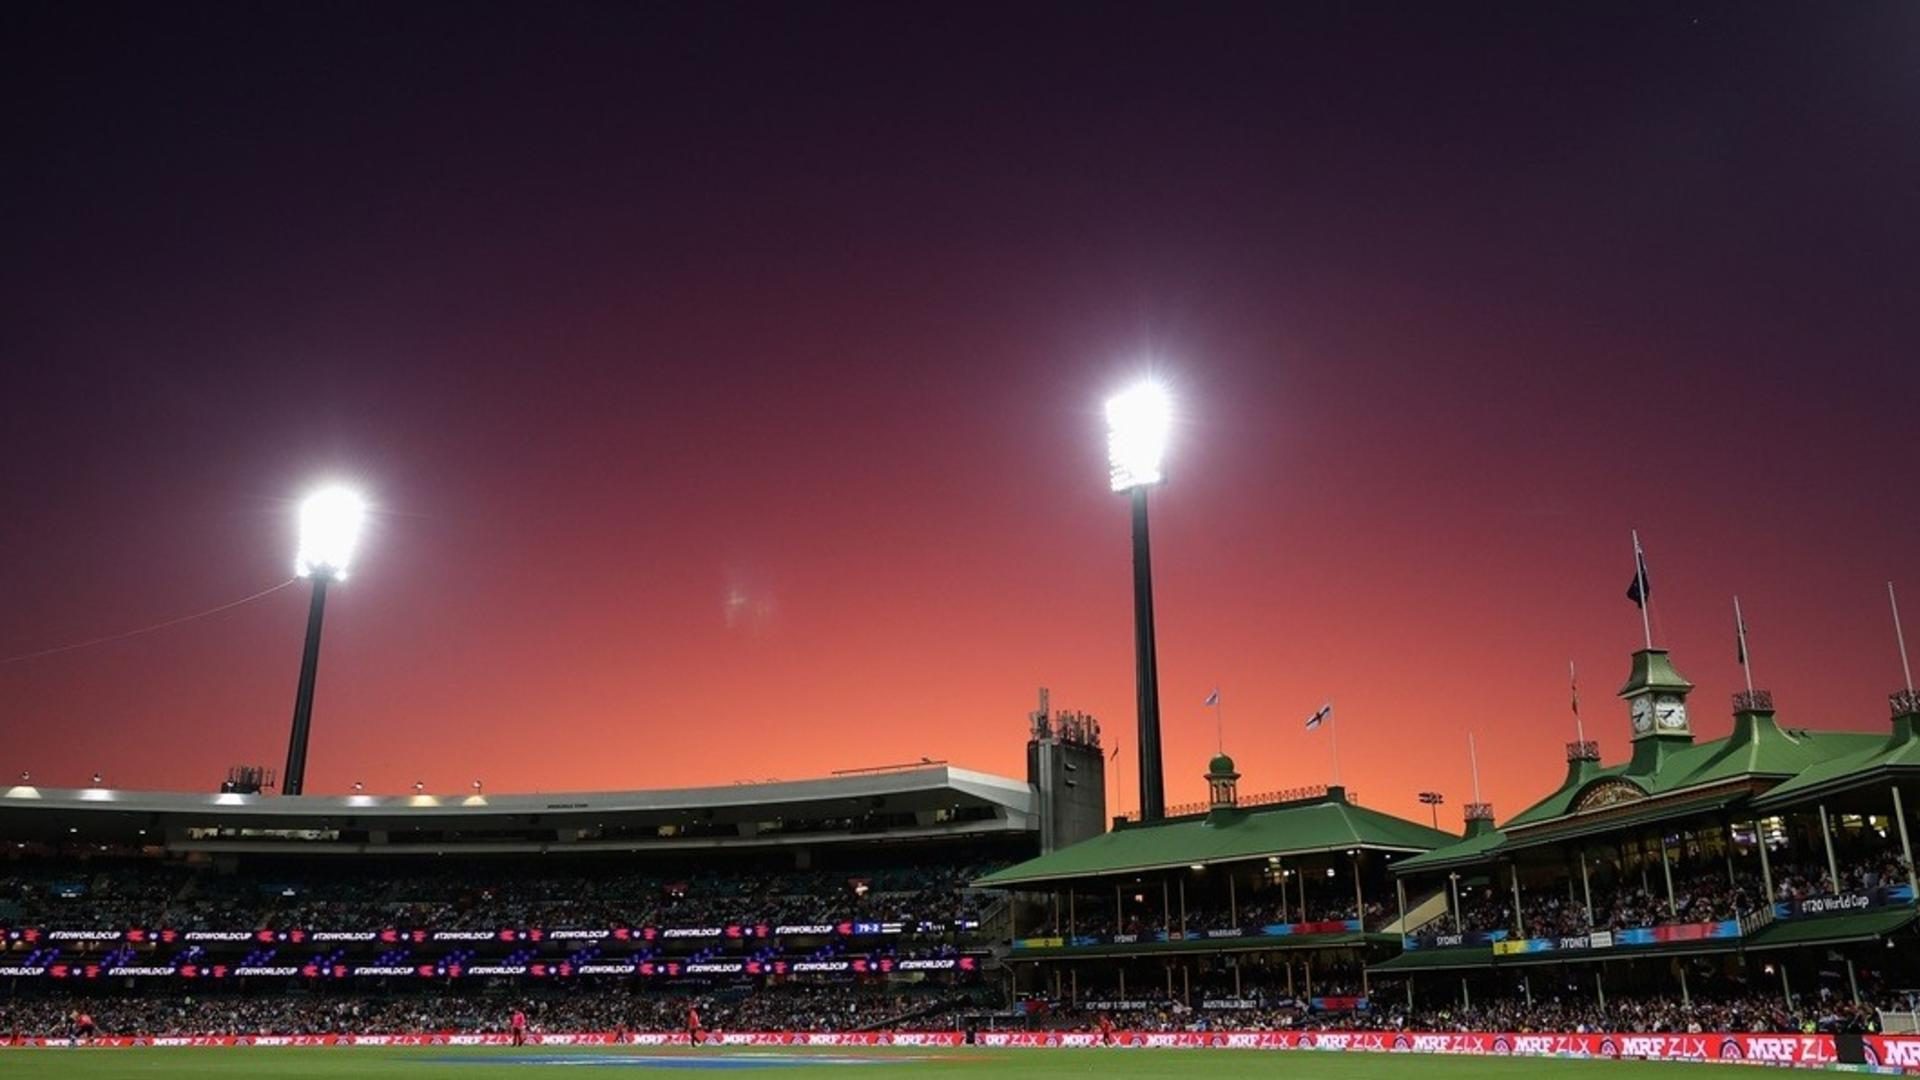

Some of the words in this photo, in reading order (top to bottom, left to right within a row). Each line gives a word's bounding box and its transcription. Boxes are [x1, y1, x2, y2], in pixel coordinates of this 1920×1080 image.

[1823, 895, 1851, 911] World
[1852, 894, 1869, 909] Cup
[1436, 935, 1463, 946] SYDNEY
[1560, 936, 1589, 949] SYDNEY
[1010, 1034, 1038, 1045] ZLX
[1061, 1034, 1094, 1046] MRF
[1146, 1034, 1178, 1046] MRF
[1178, 1034, 1205, 1046] ZLX
[1227, 1034, 1259, 1047] MRF
[1259, 1034, 1290, 1048] ZLX
[1315, 1035, 1351, 1048] MRF
[1351, 1035, 1383, 1048] ZLX
[1412, 1036, 1451, 1050] MRF
[1452, 1036, 1484, 1050] ZLX
[1513, 1037, 1554, 1052] MRF
[1555, 1037, 1590, 1053] ZLX
[1621, 1038, 1665, 1056] MRF
[1668, 1038, 1708, 1057] ZLX
[1746, 1039, 1798, 1061] MRF
